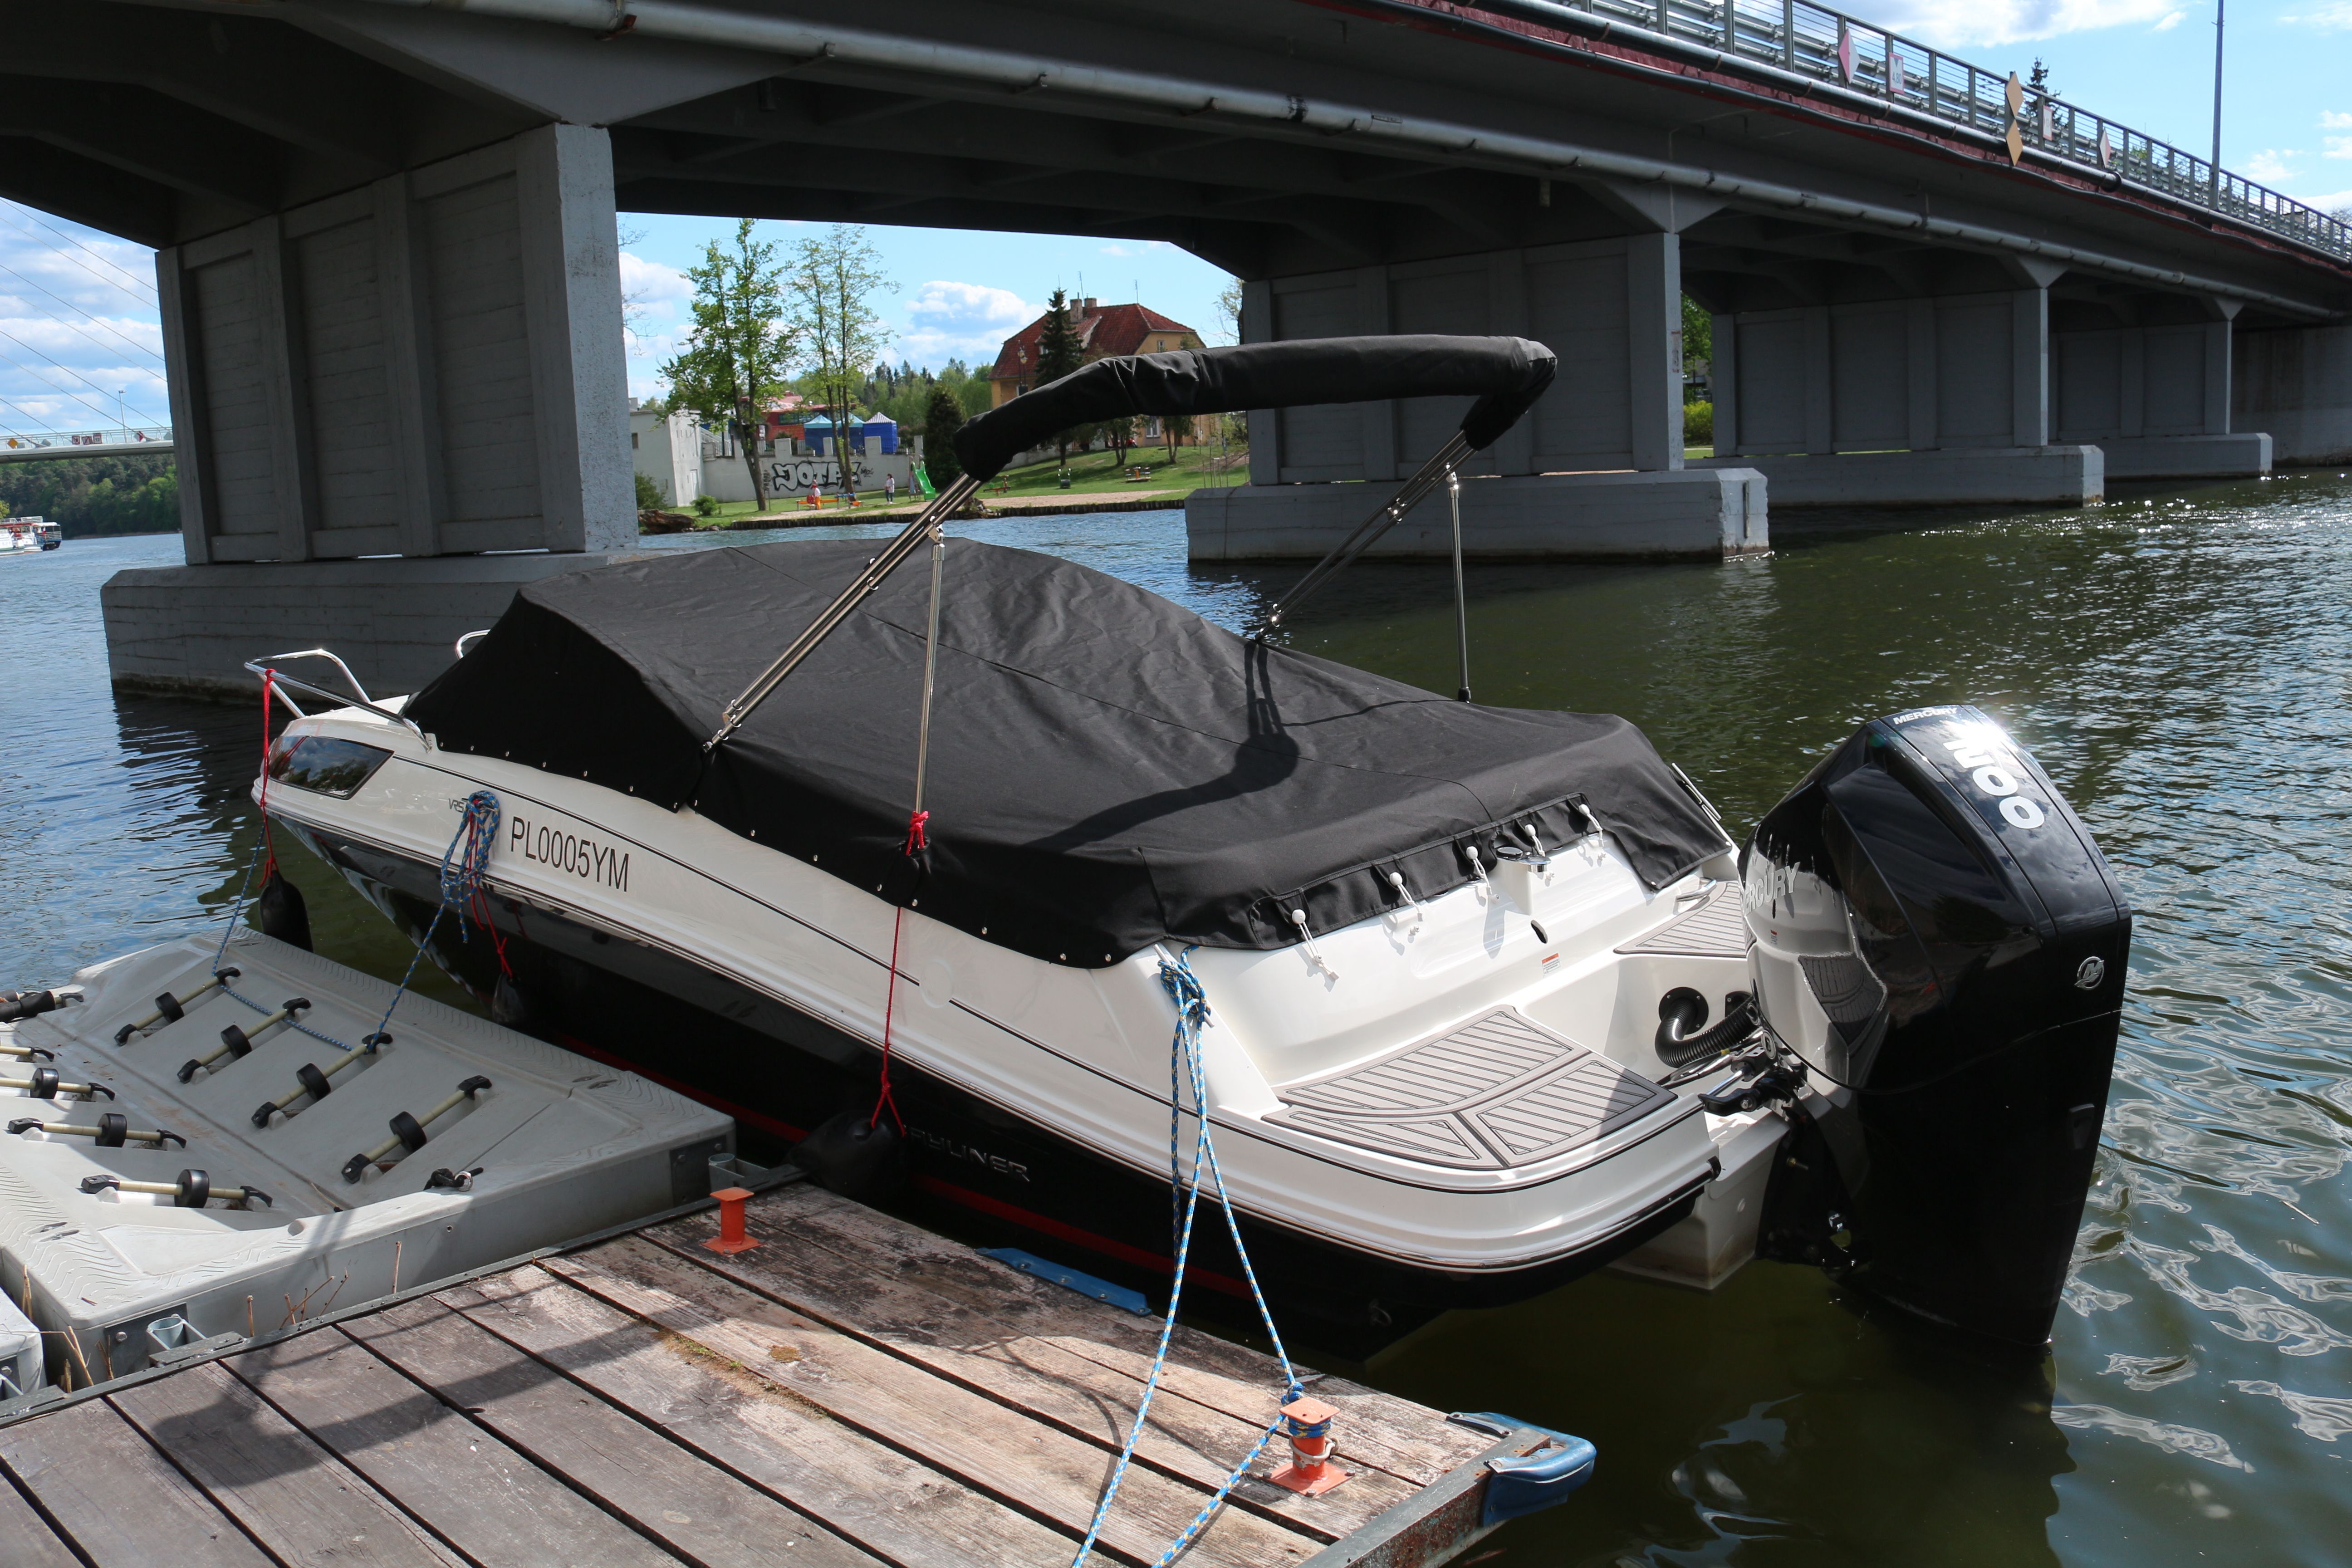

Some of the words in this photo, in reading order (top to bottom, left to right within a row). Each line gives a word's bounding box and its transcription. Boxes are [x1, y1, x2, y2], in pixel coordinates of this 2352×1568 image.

[1893, 708, 1958, 725] MERCURY
[510, 816, 629, 892] PL0005YM
[1745, 862, 1800, 916] ERCURY
